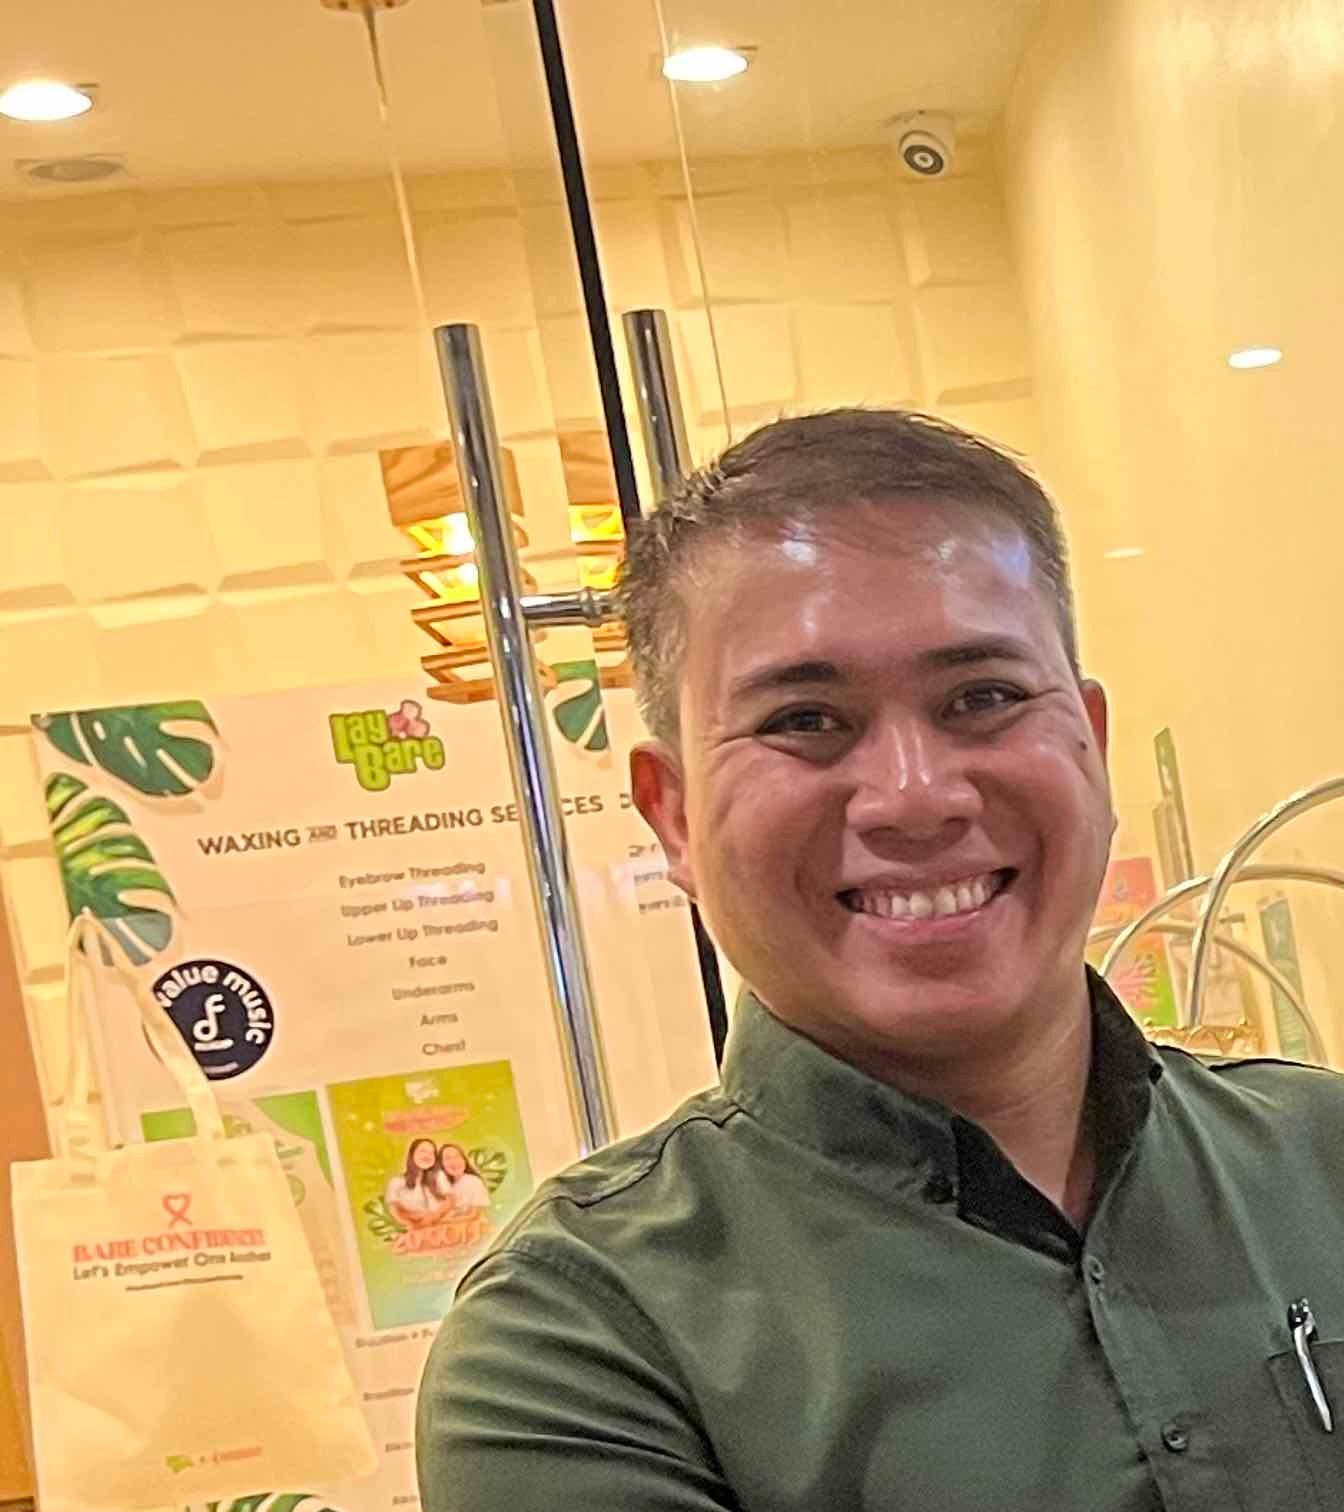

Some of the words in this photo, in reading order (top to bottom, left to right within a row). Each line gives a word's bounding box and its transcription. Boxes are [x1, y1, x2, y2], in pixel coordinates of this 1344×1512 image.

[329, 709, 387, 764] Lay
[355, 736, 445, 792] Bare
[197, 829, 301, 855] WAXING
[345, 807, 483, 840] THREADING
[223, 971, 272, 1045] music
